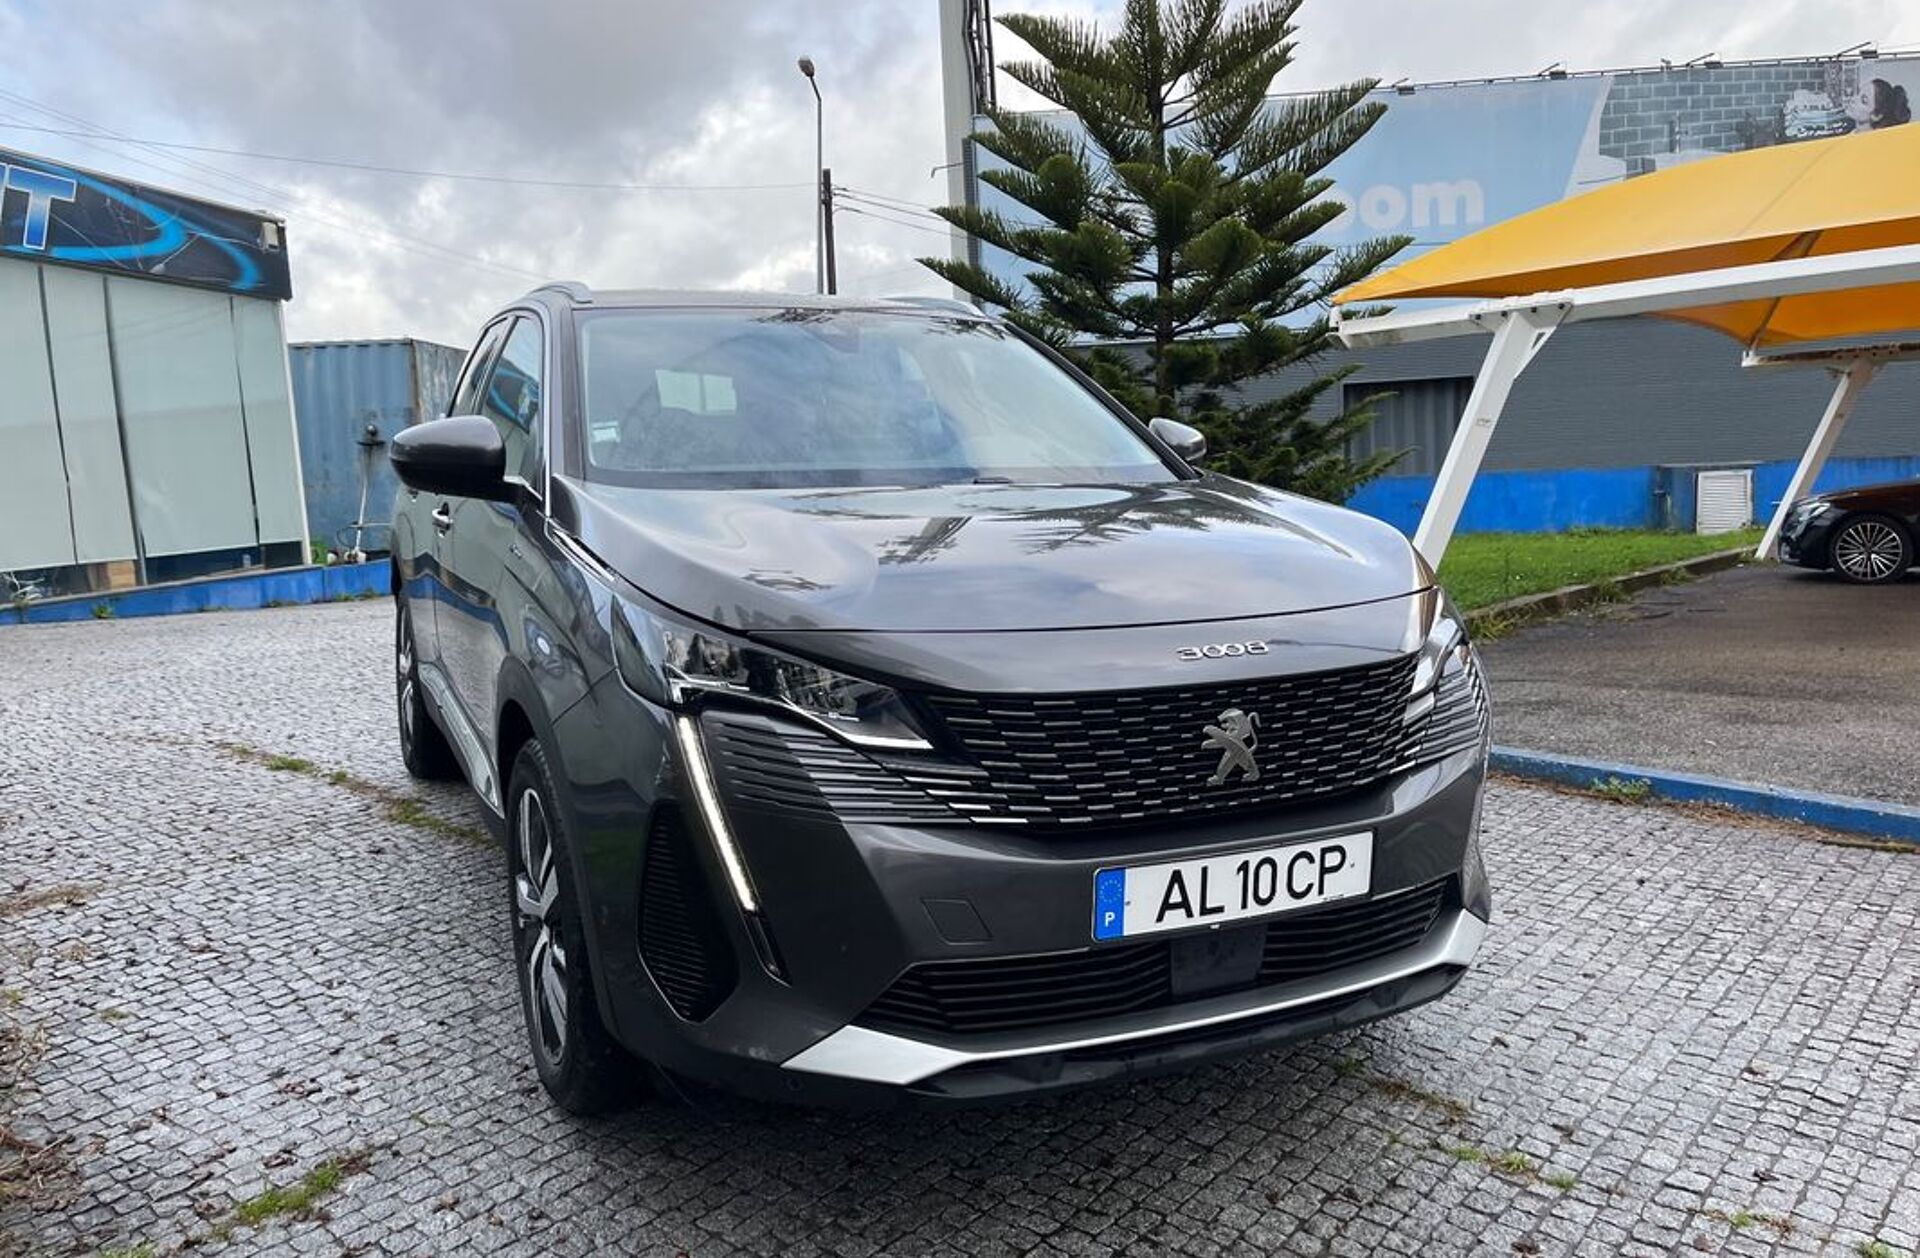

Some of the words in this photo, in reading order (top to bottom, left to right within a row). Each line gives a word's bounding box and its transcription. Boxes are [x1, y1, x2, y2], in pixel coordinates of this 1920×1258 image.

[0, 163, 77, 250] T
[1177, 640, 1268, 661] 3008
[1155, 865, 1225, 923] AL
[1236, 856, 1278, 911] 10
[1286, 844, 1347, 900] CP
[1104, 911, 1116, 927] P
